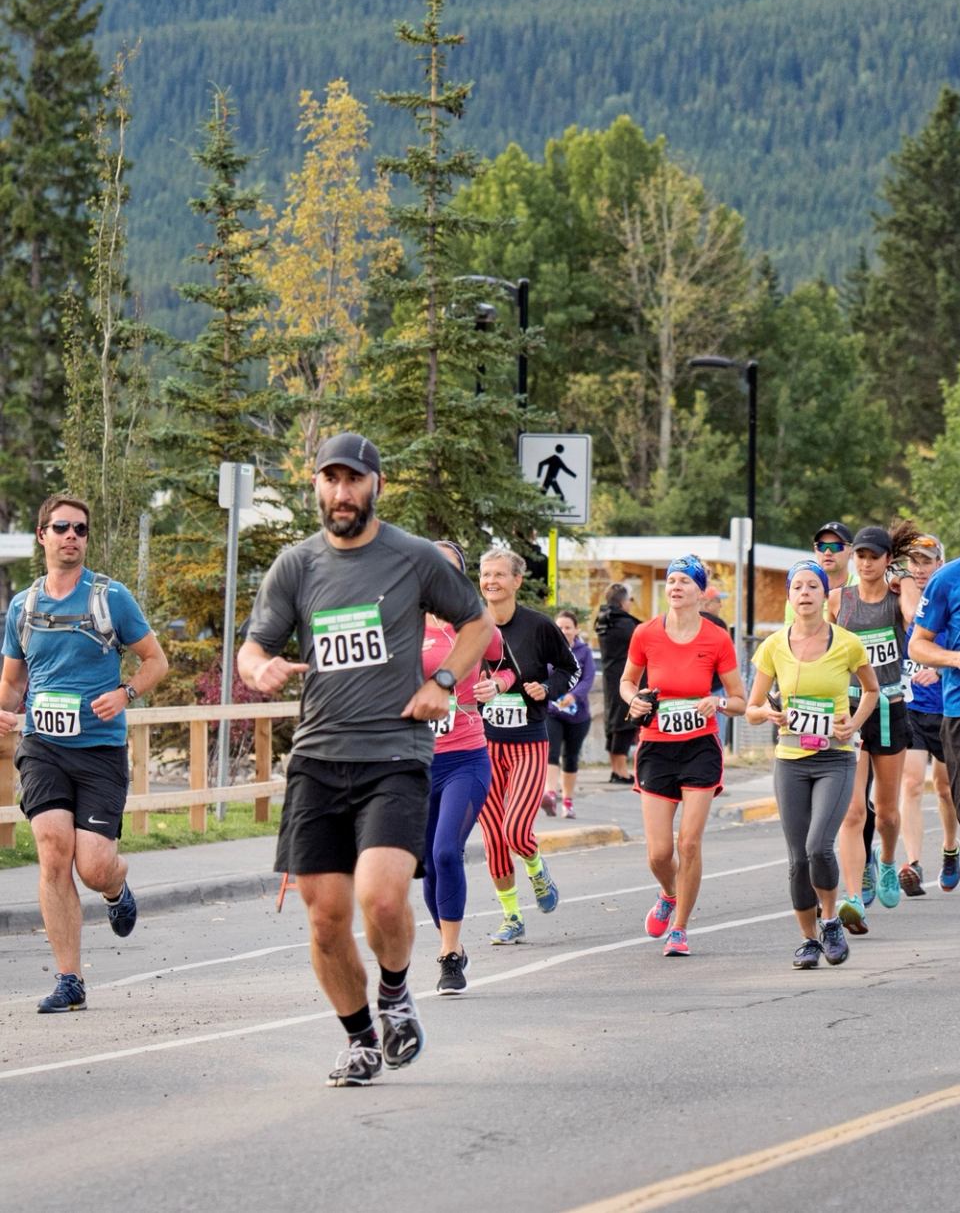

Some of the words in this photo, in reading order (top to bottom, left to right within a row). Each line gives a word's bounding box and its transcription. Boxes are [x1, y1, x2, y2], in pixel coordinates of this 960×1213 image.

[320, 630, 381, 666] 2056
[867, 642, 896, 664] 764
[35, 710, 75, 733] 2067
[486, 707, 522, 725] 2871
[661, 710, 704, 732] 2886
[789, 710, 829, 735] 2711
